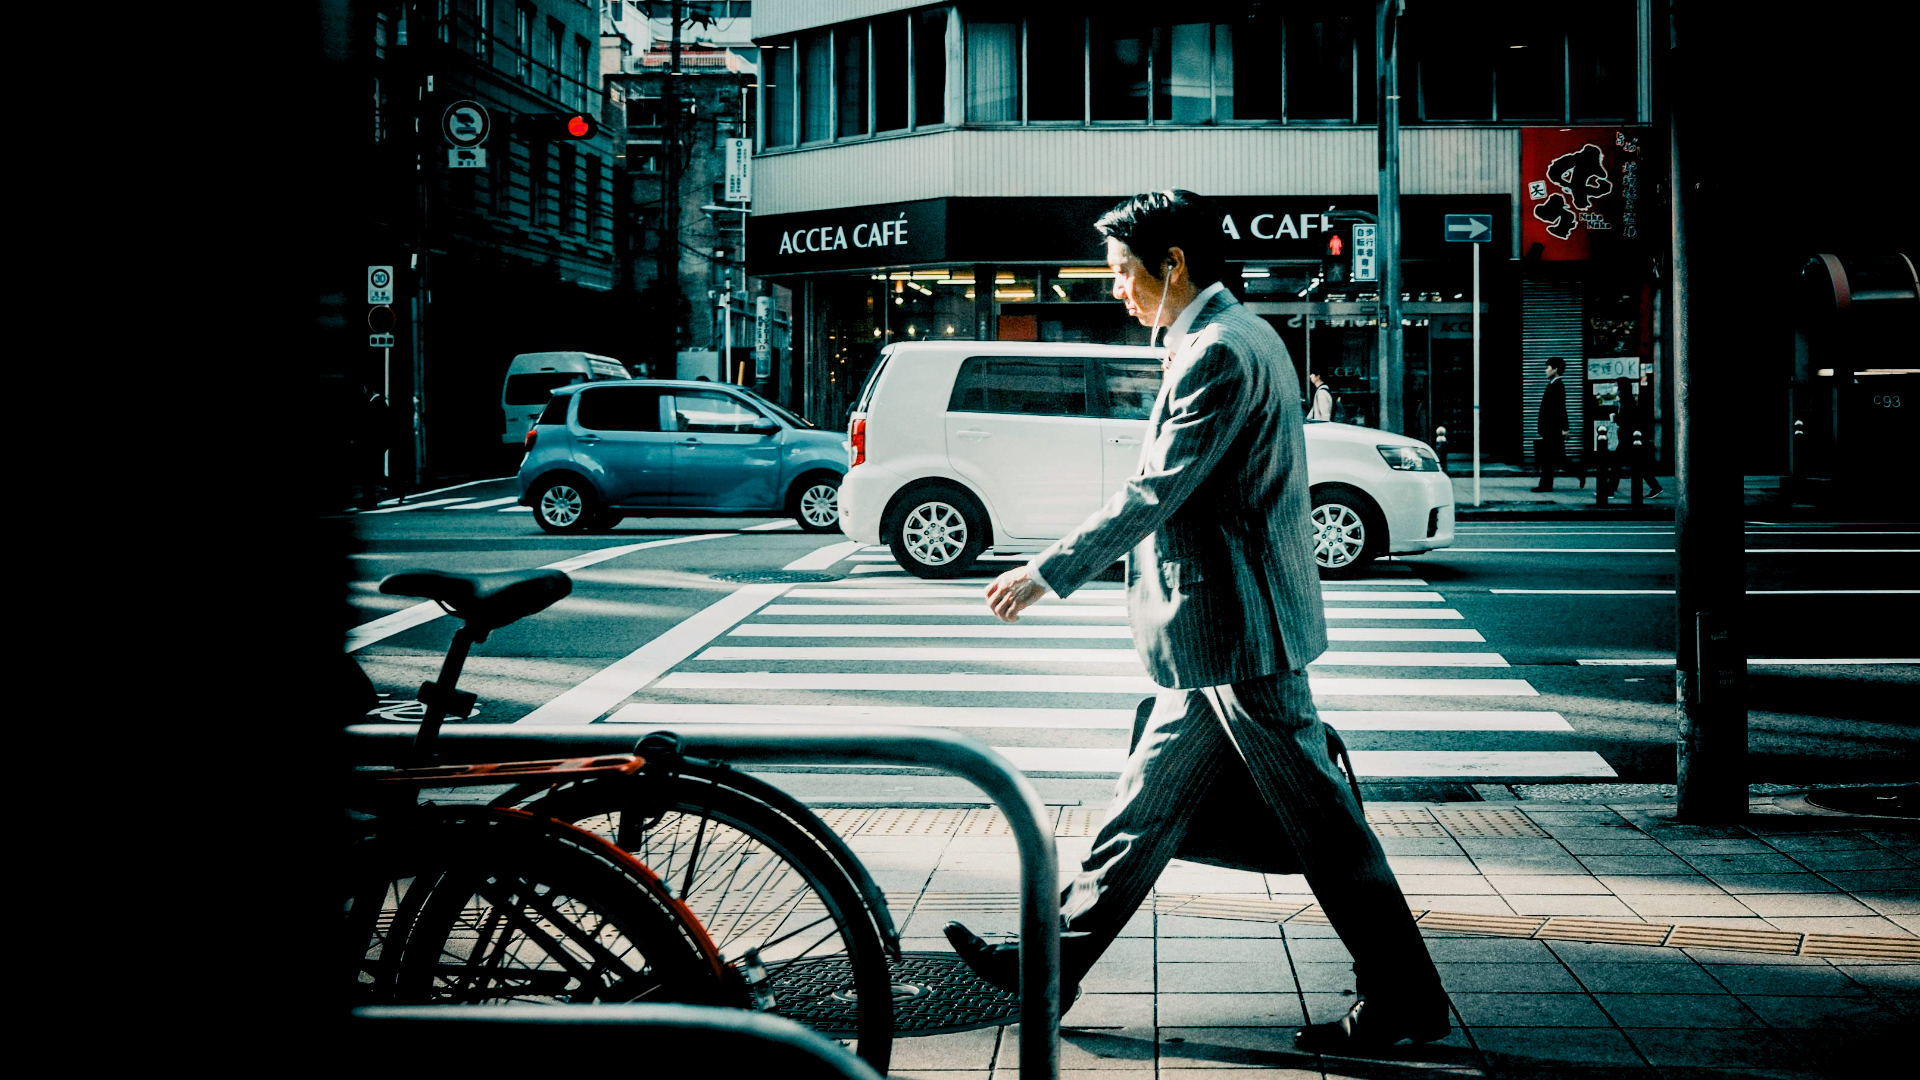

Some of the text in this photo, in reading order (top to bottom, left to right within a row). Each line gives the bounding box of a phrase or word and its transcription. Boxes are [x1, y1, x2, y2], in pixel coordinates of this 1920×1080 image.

[779, 212, 908, 255] ACCEA CAFÉ
[1357, 228, 1365, 257] 自転車
[1366, 228, 1374, 257] 歩行者
[376, 274, 386, 283] 30
